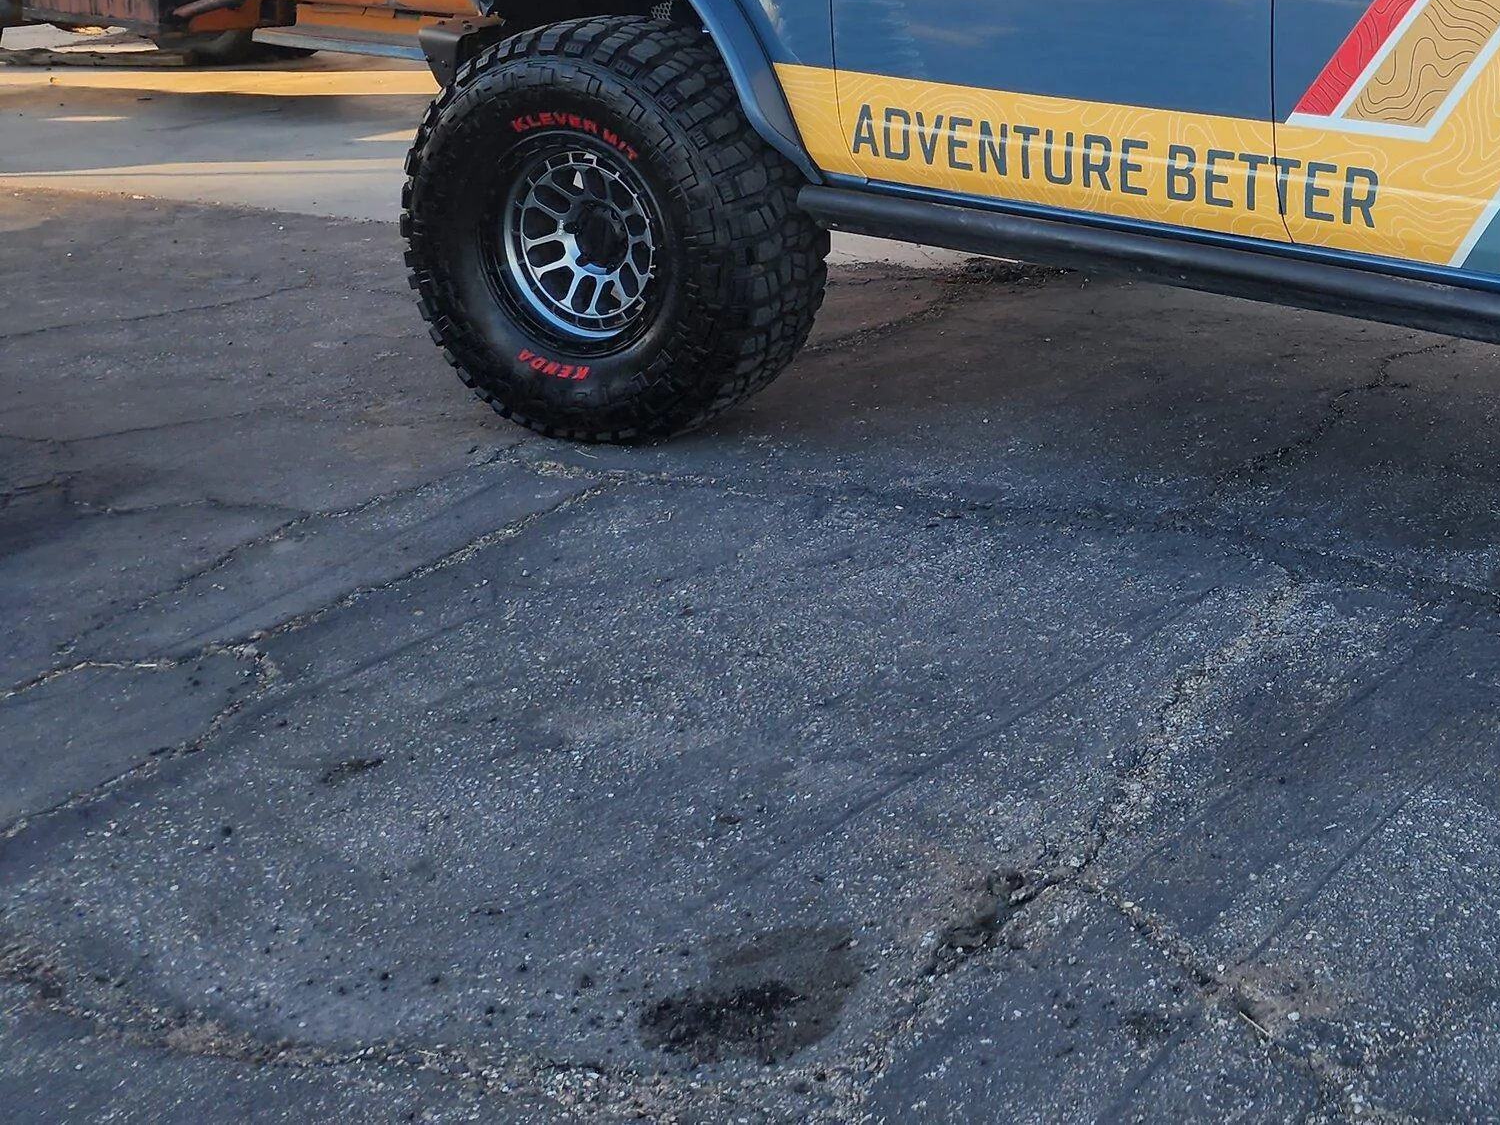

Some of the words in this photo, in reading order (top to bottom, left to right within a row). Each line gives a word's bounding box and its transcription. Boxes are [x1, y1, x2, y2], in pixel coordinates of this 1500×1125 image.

[512, 111, 598, 134] KLEVER
[851, 103, 1149, 197] ADVENTURE
[1165, 143, 1379, 229] BETTER
[516, 348, 590, 381] KENDA
